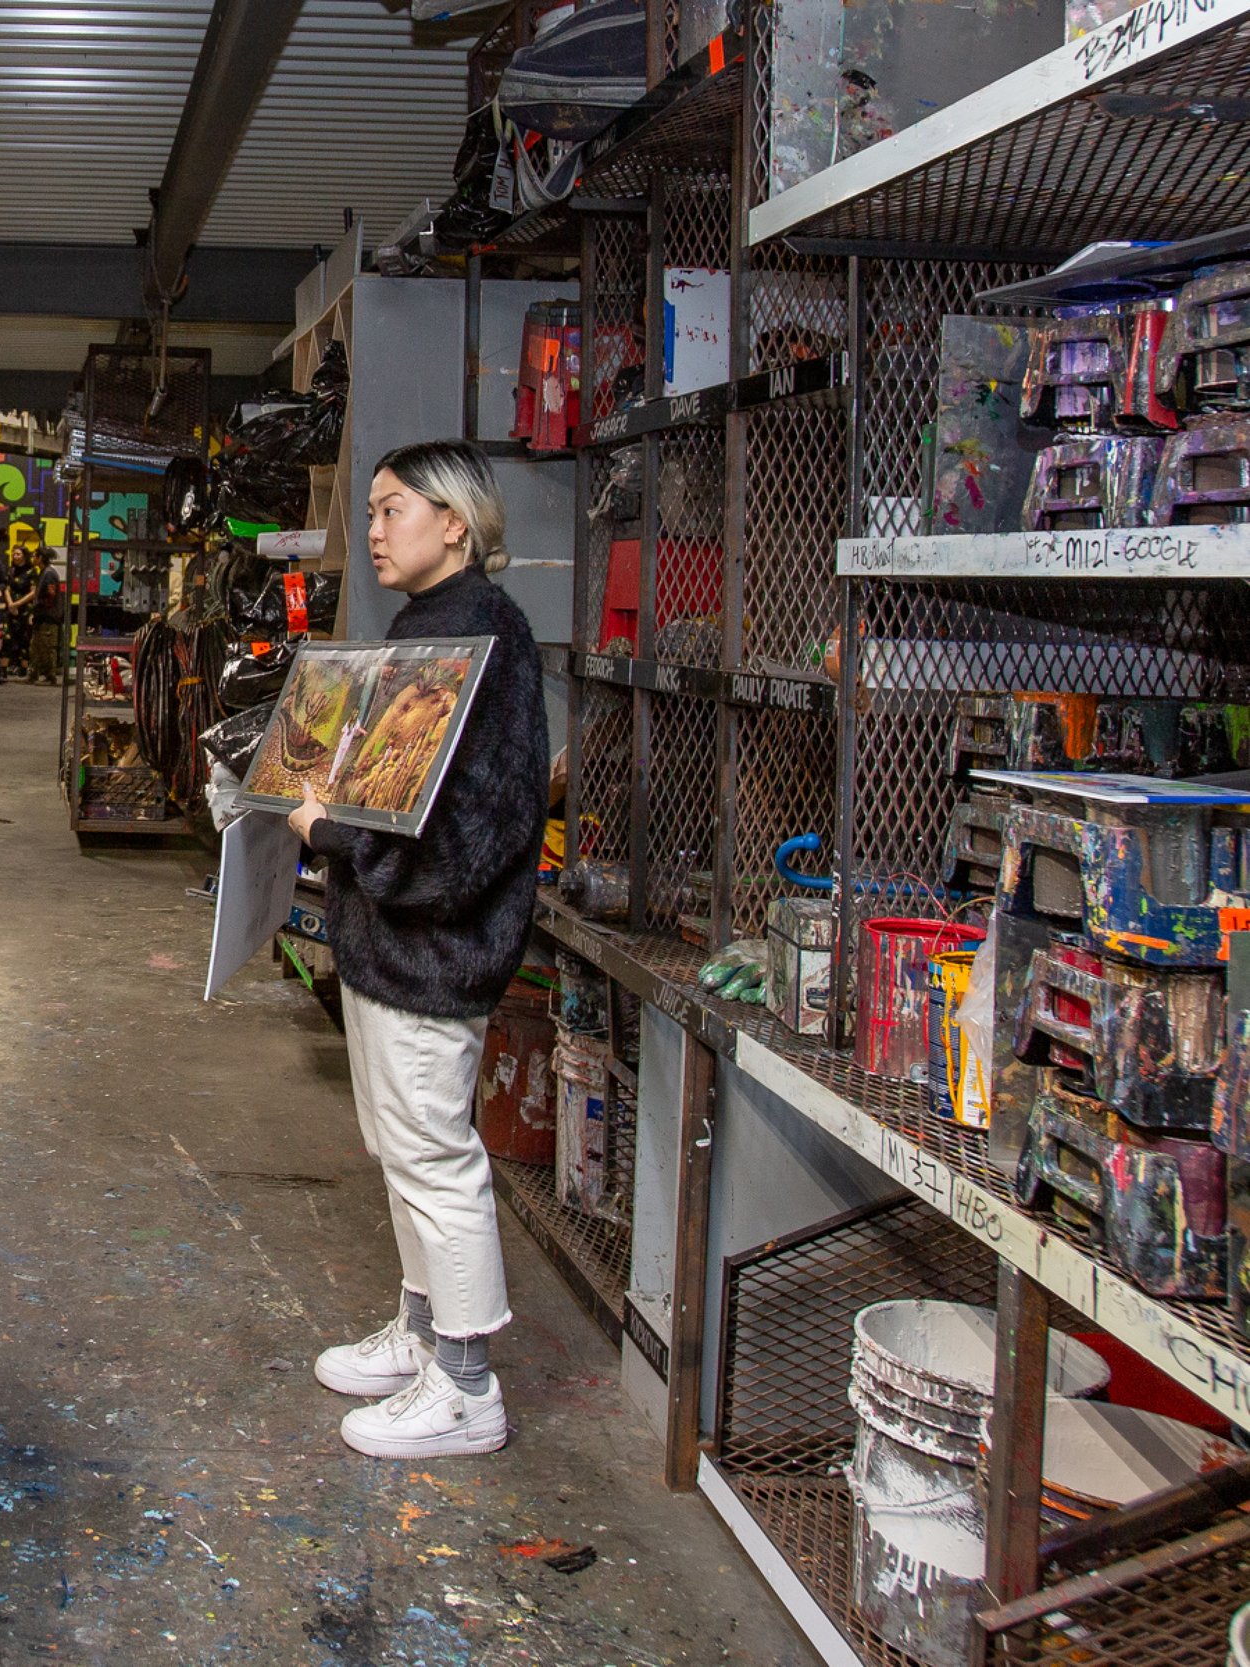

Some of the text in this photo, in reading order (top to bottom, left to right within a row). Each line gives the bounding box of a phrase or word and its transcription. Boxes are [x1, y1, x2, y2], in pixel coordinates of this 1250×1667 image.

[769, 367, 796, 399] IAN
[669, 392, 701, 422] DAVE
[731, 674, 813, 711] PAULY PIRATE
[956, 1182, 1003, 1241] HBO
